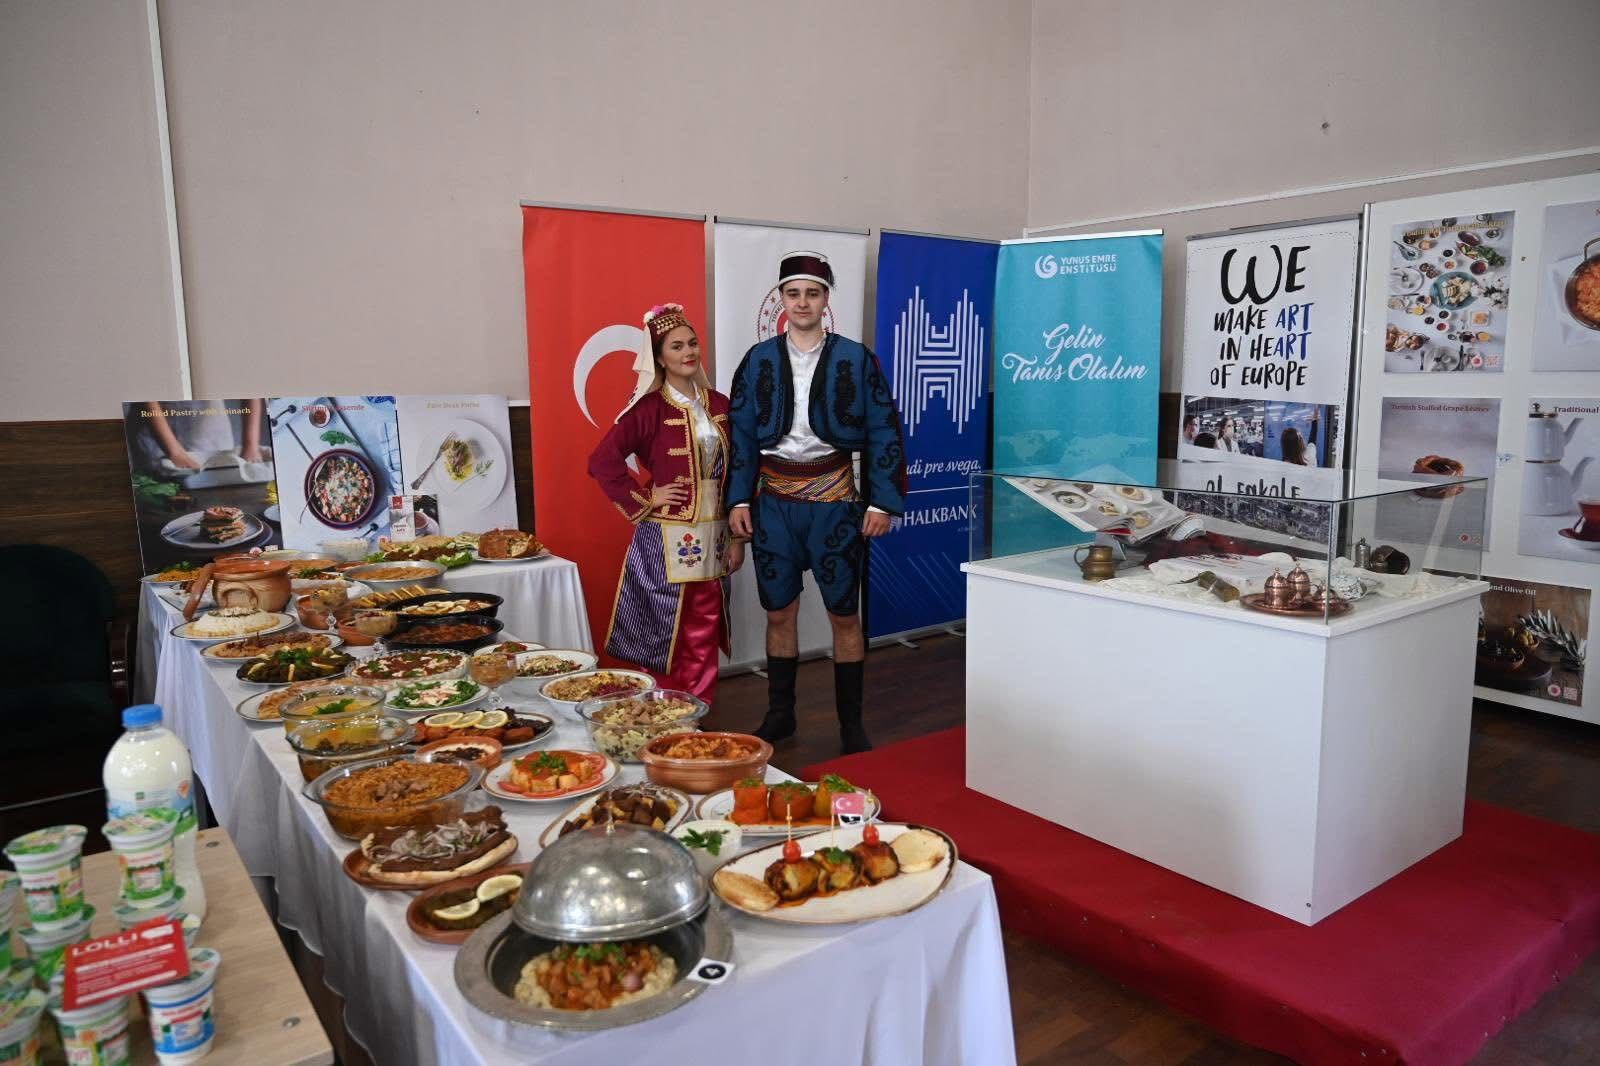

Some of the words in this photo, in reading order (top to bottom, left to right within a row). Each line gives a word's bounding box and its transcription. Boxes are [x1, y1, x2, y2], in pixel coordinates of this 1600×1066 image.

[1060, 256, 1090, 265] YUNUS
[1091, 254, 1118, 263] EMRE
[1221, 245, 1311, 304] WE
[1214, 305, 1268, 335] MAKE
[1275, 302, 1315, 332] ART
[1043, 323, 1106, 365] Gelin
[1220, 336, 1242, 361] IN
[1250, 332, 1312, 362] HEART
[1210, 363, 1236, 389] OF
[1241, 360, 1308, 392] EUROPE
[170, 409, 198, 418] Pastry
[923, 462, 944, 478] pre
[904, 504, 977, 527] HALKBANK
